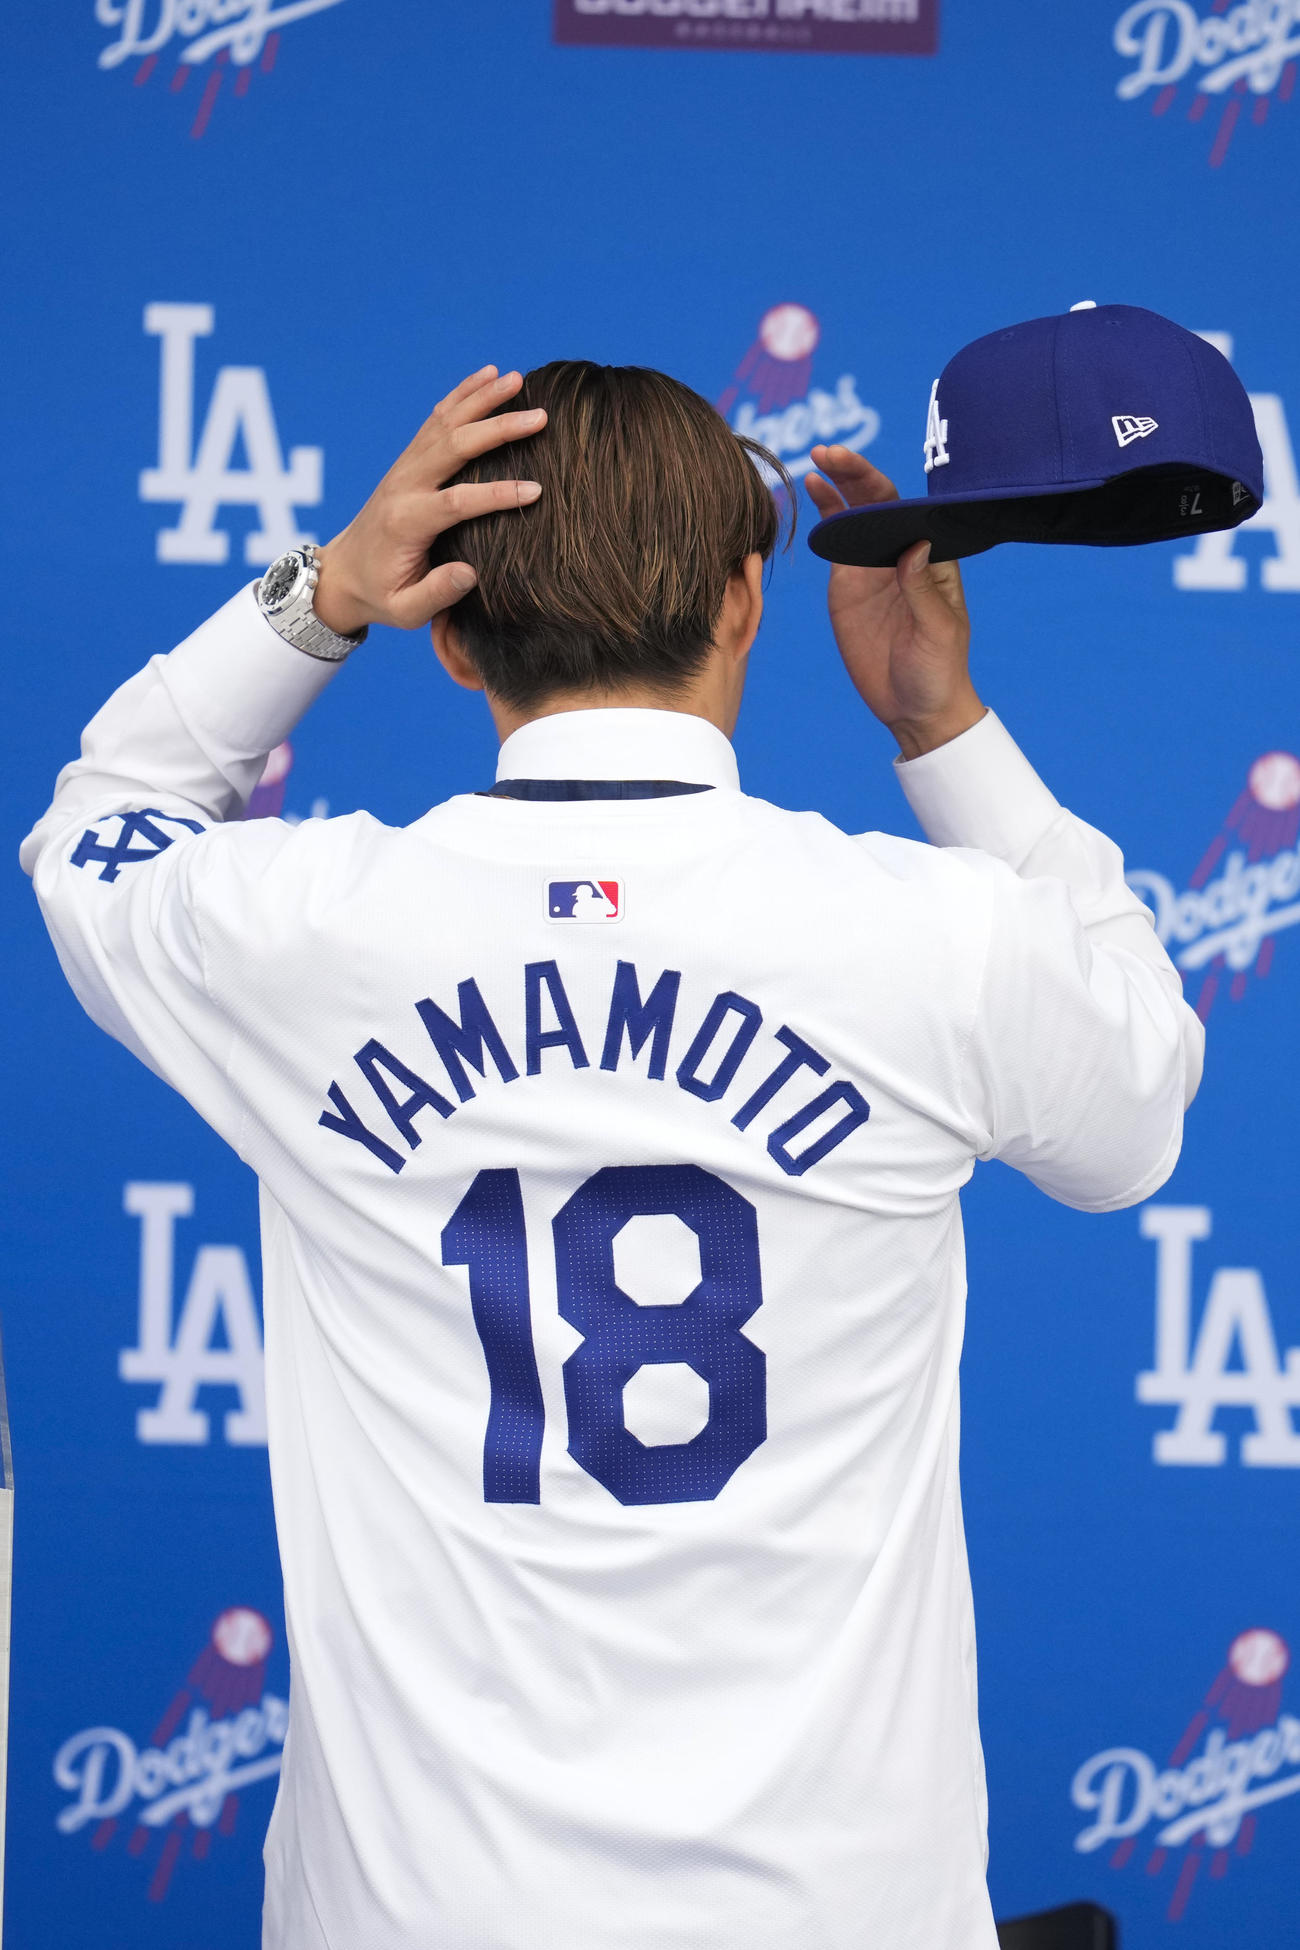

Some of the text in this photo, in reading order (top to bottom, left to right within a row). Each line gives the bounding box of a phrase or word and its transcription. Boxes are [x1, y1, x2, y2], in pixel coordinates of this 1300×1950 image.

[138, 303, 324, 565] LA
[318, 959, 871, 1177] YAMAMOTO
[119, 1181, 268, 1445] LA
[440, 1164, 768, 1506] 18
[1136, 1205, 1300, 1468] LA
